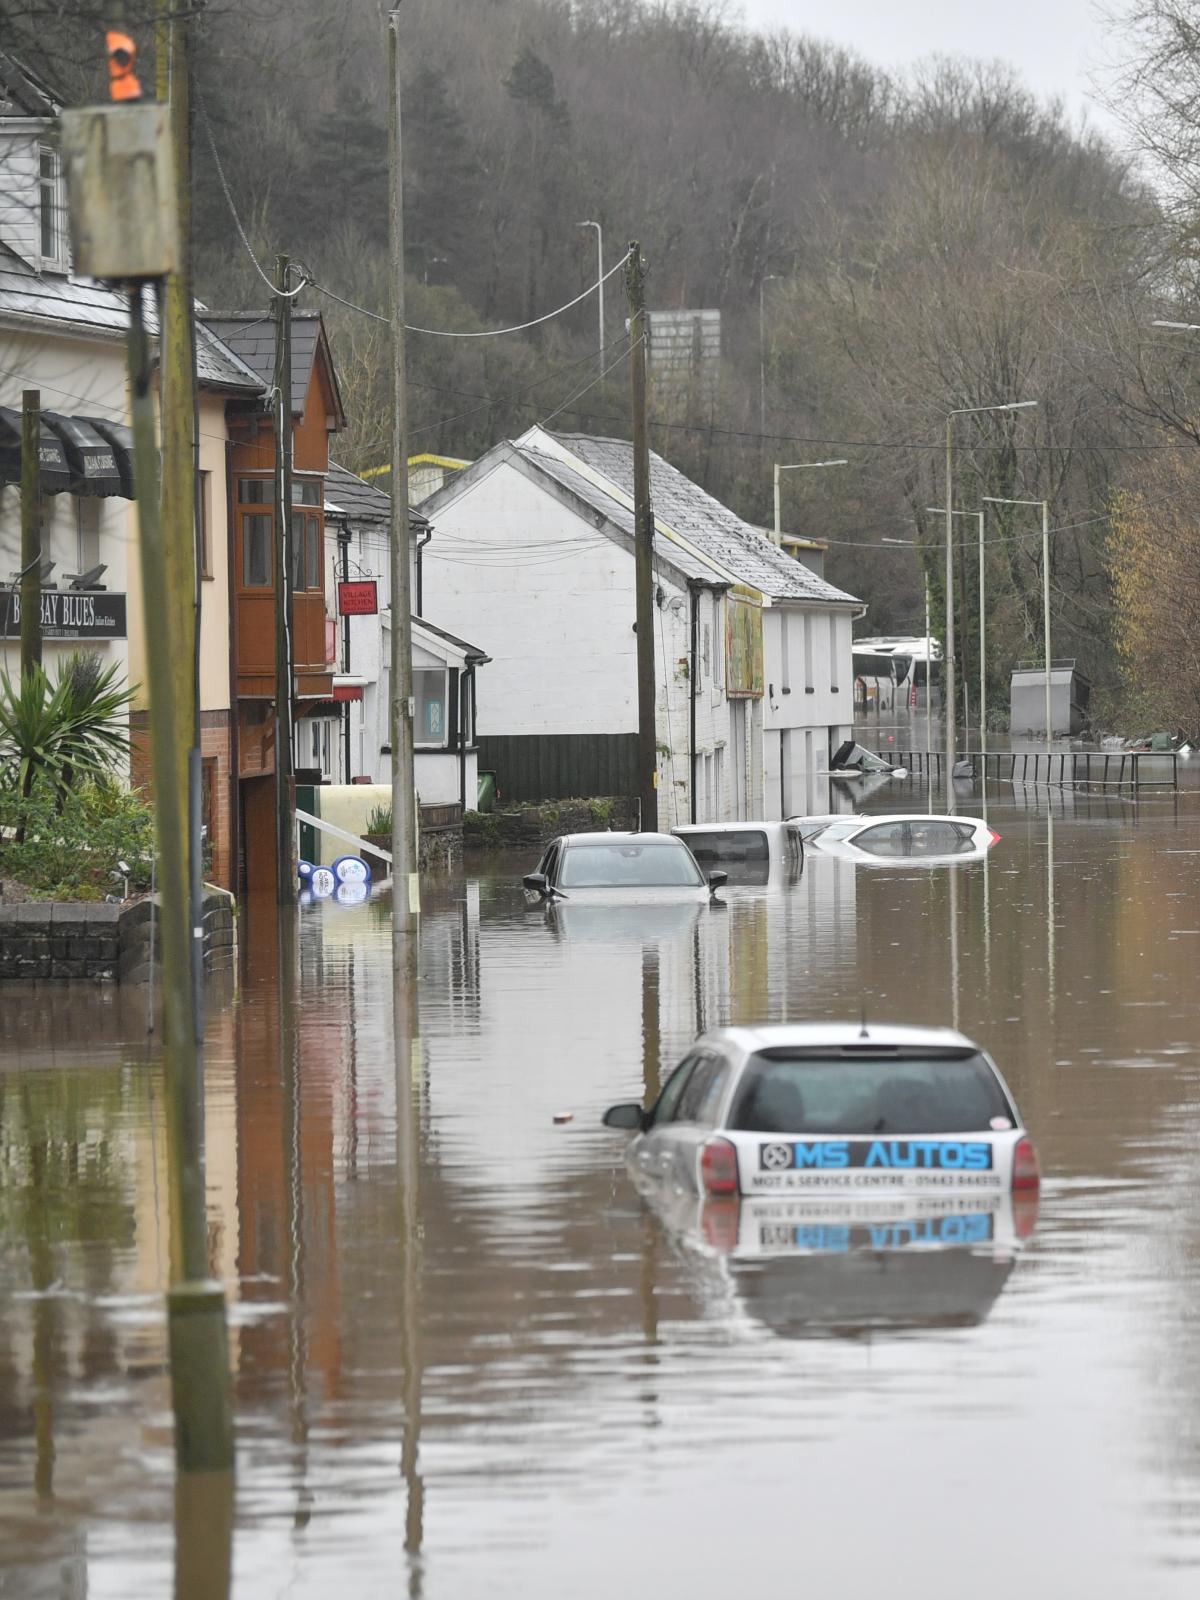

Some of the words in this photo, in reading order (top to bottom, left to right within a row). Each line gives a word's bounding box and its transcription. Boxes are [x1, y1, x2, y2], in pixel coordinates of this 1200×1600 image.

[63, 597, 95, 627] BLUES
[795, 1141, 849, 1169] MS
[864, 1141, 990, 1170] AUTOS
[752, 1176, 781, 1187] MOT
[799, 1176, 851, 1187] SERVICE
[855, 1176, 904, 1187] CENTRE
